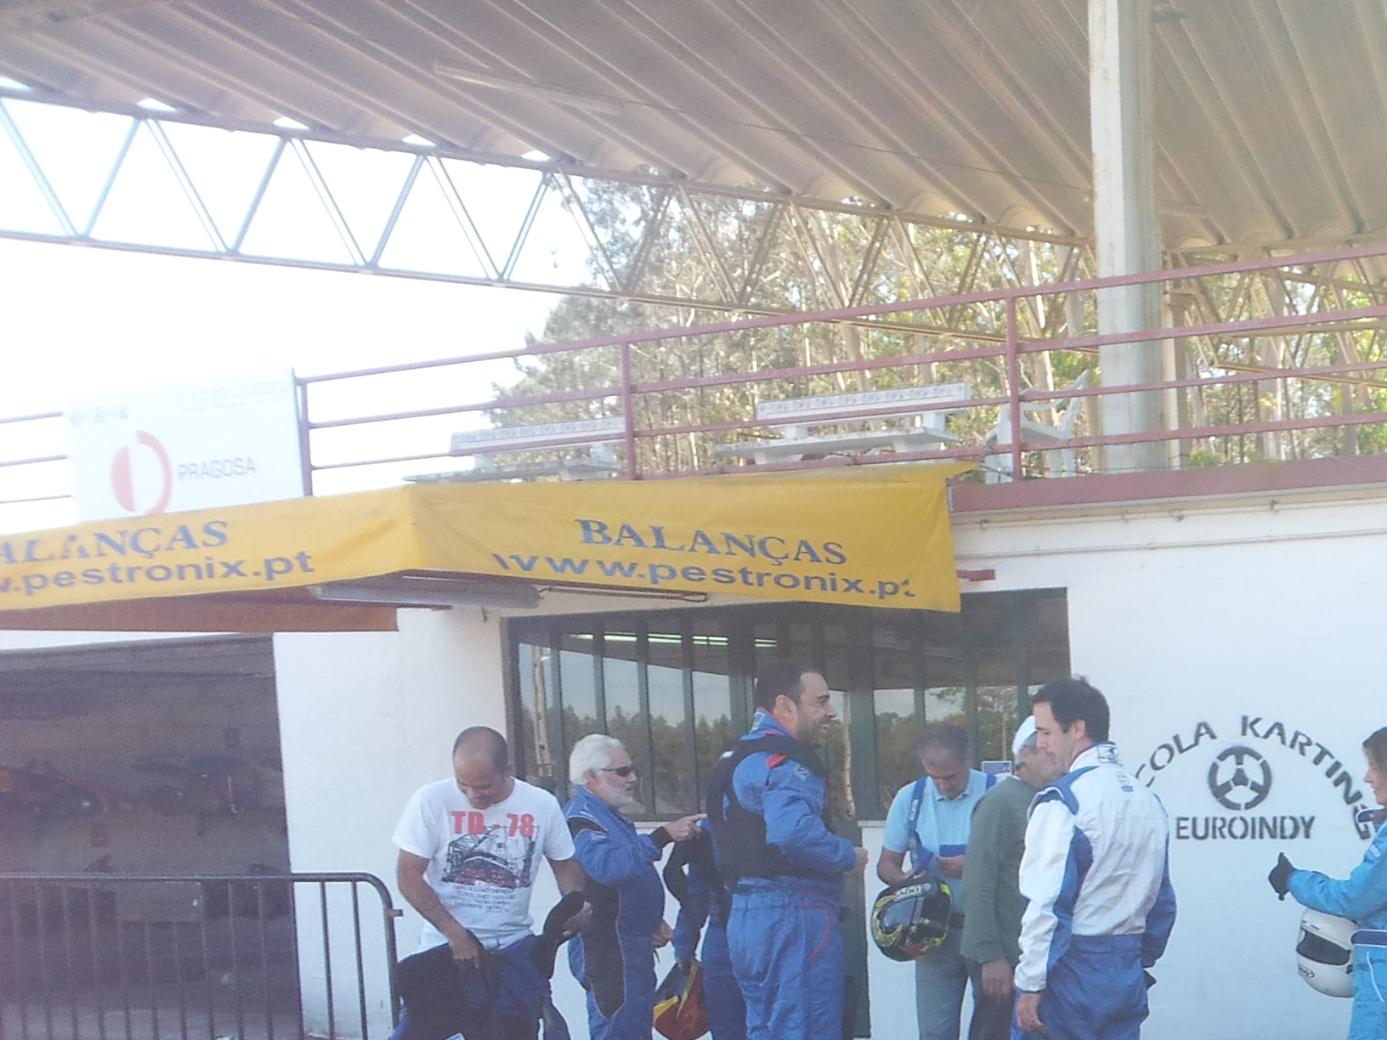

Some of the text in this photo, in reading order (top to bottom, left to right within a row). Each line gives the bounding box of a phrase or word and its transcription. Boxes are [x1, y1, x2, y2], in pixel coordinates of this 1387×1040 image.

[178, 457, 257, 482] PRAGOSA
[575, 518, 848, 566] BALANÇAS
[1175, 815, 1316, 841] EUROINDY
